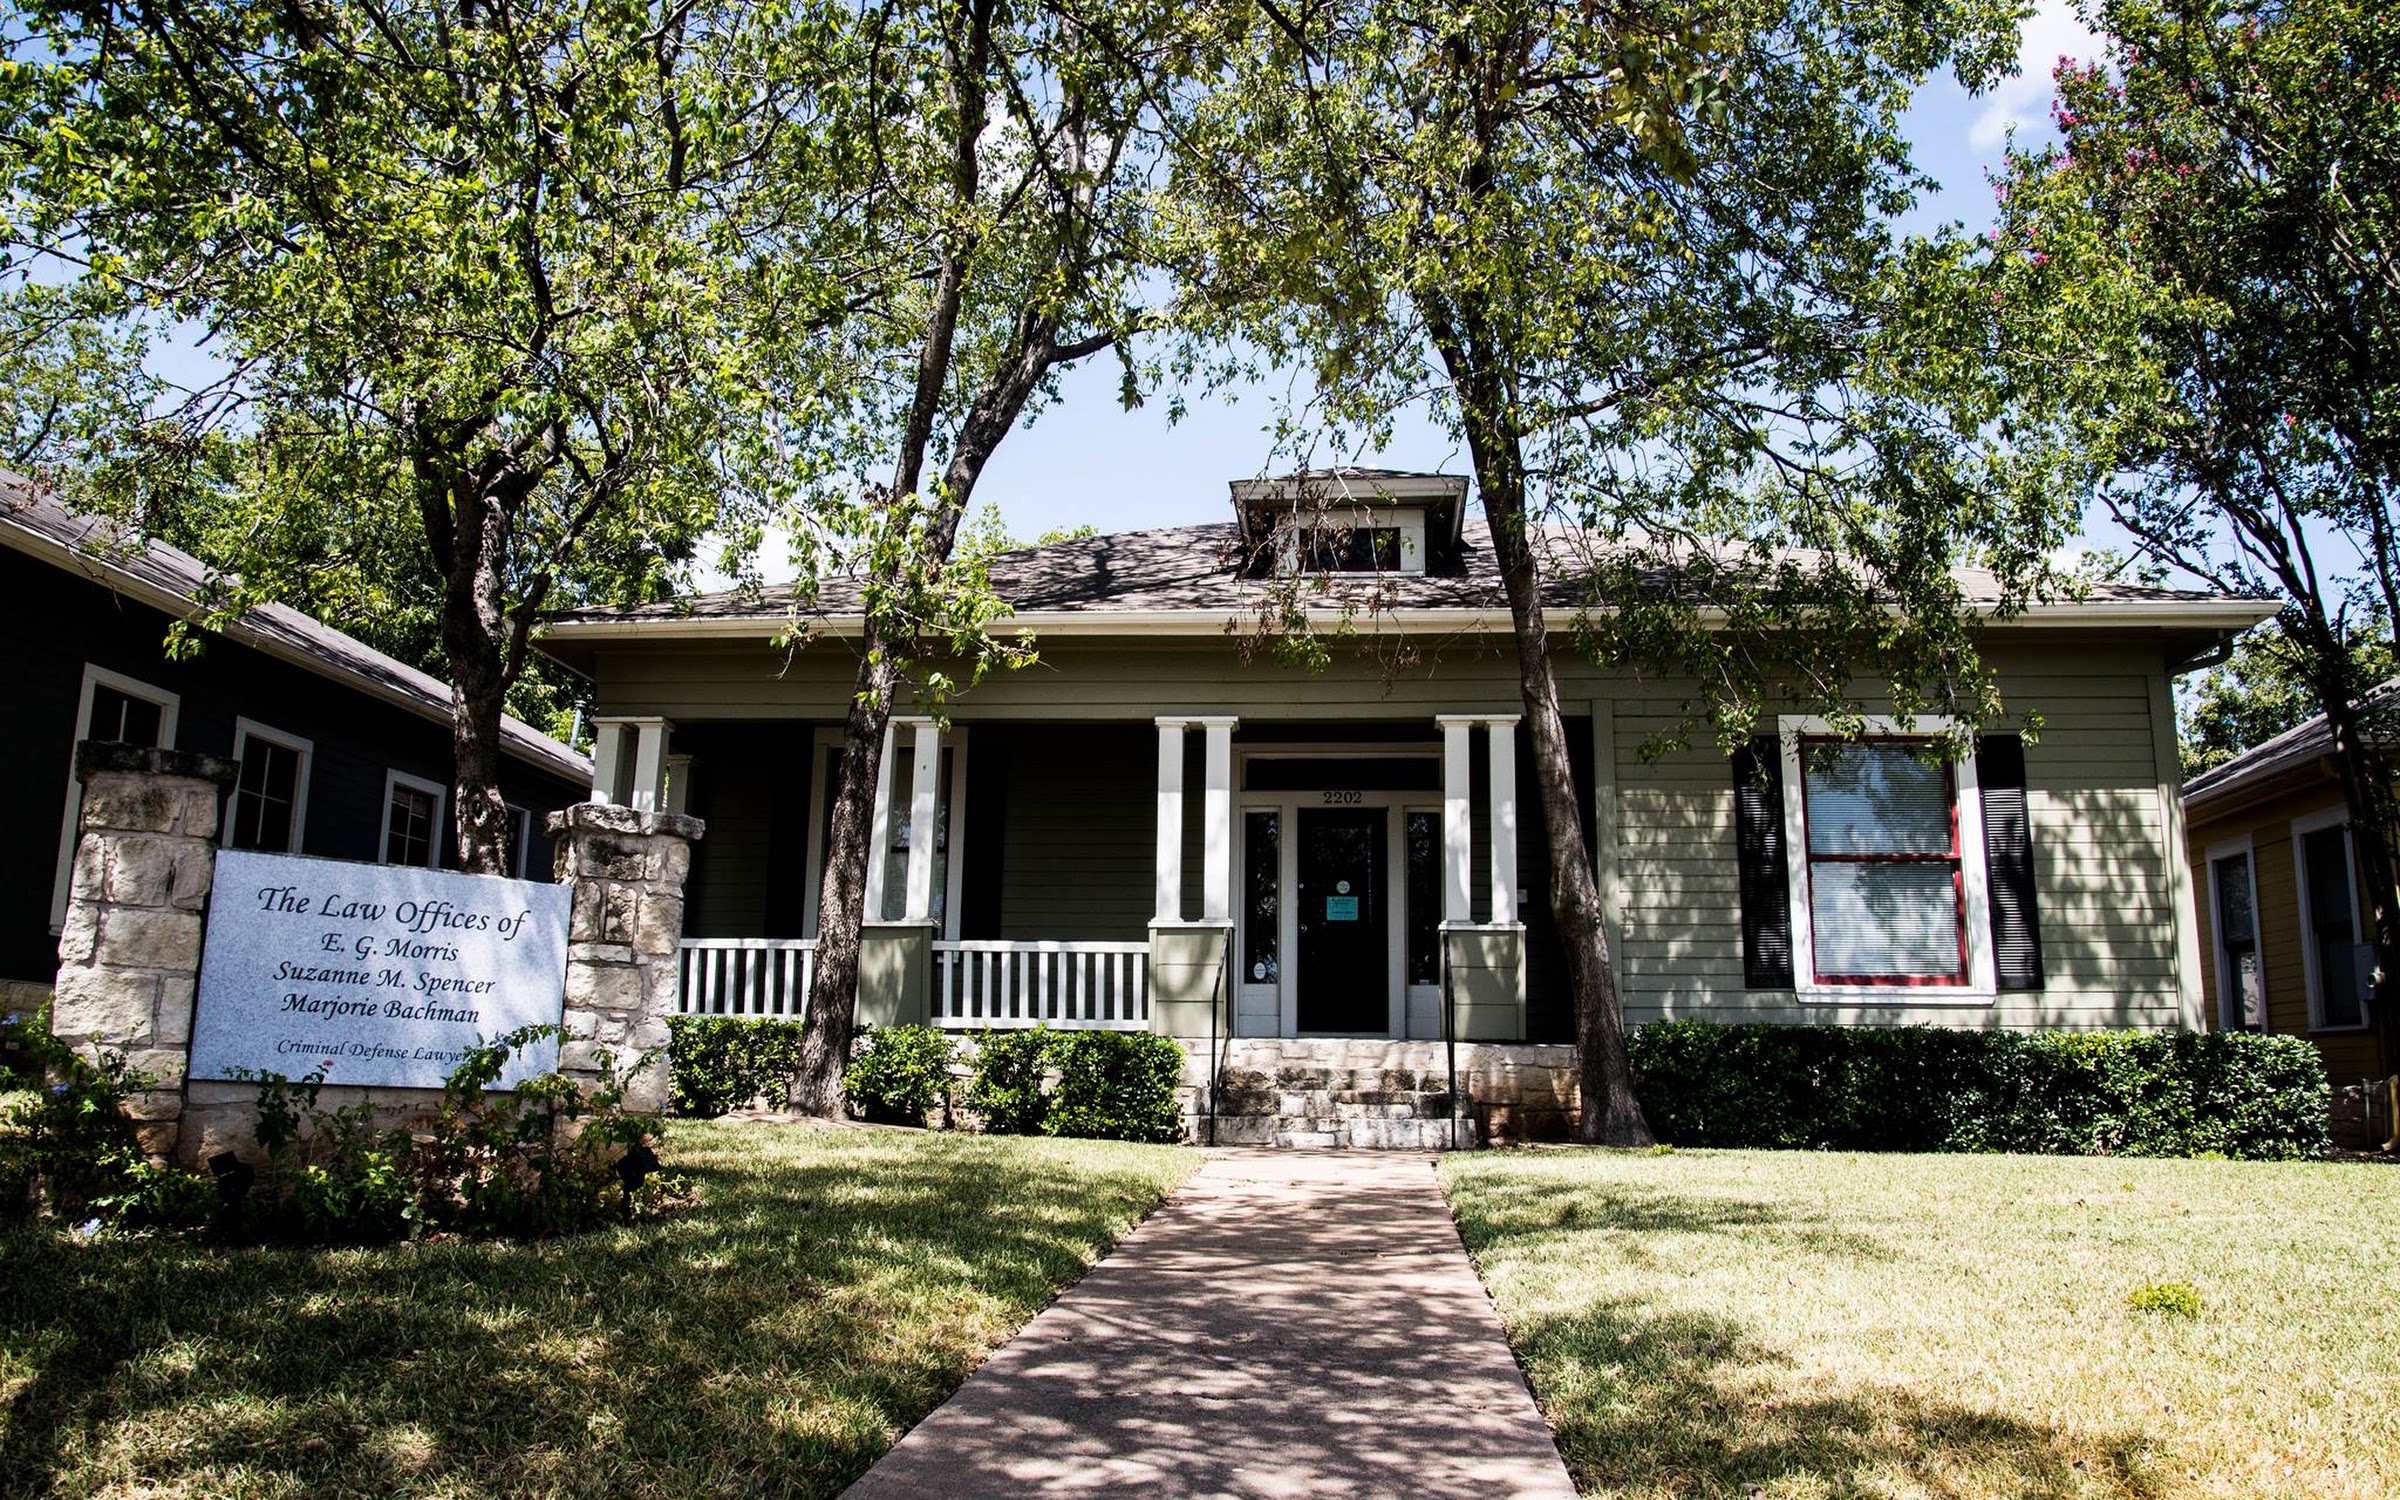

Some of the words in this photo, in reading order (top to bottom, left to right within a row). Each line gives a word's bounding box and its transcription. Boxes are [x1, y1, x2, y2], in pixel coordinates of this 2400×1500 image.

[1323, 791, 1361, 804] 2202
[257, 887, 310, 914] The
[318, 894, 386, 922] Law
[395, 900, 490, 933] Offices
[497, 909, 531, 940] of
[321, 933, 344, 952] E.
[355, 936, 377, 961] G.
[385, 939, 459, 962] Morris
[273, 961, 370, 986] Suzanne
[376, 969, 406, 988] M.
[413, 972, 496, 995] Spencer
[280, 993, 377, 1021] Marjorie
[383, 1000, 480, 1024] Bachman
[277, 1039, 346, 1056] Criminal
[352, 1043, 409, 1060] Defense
